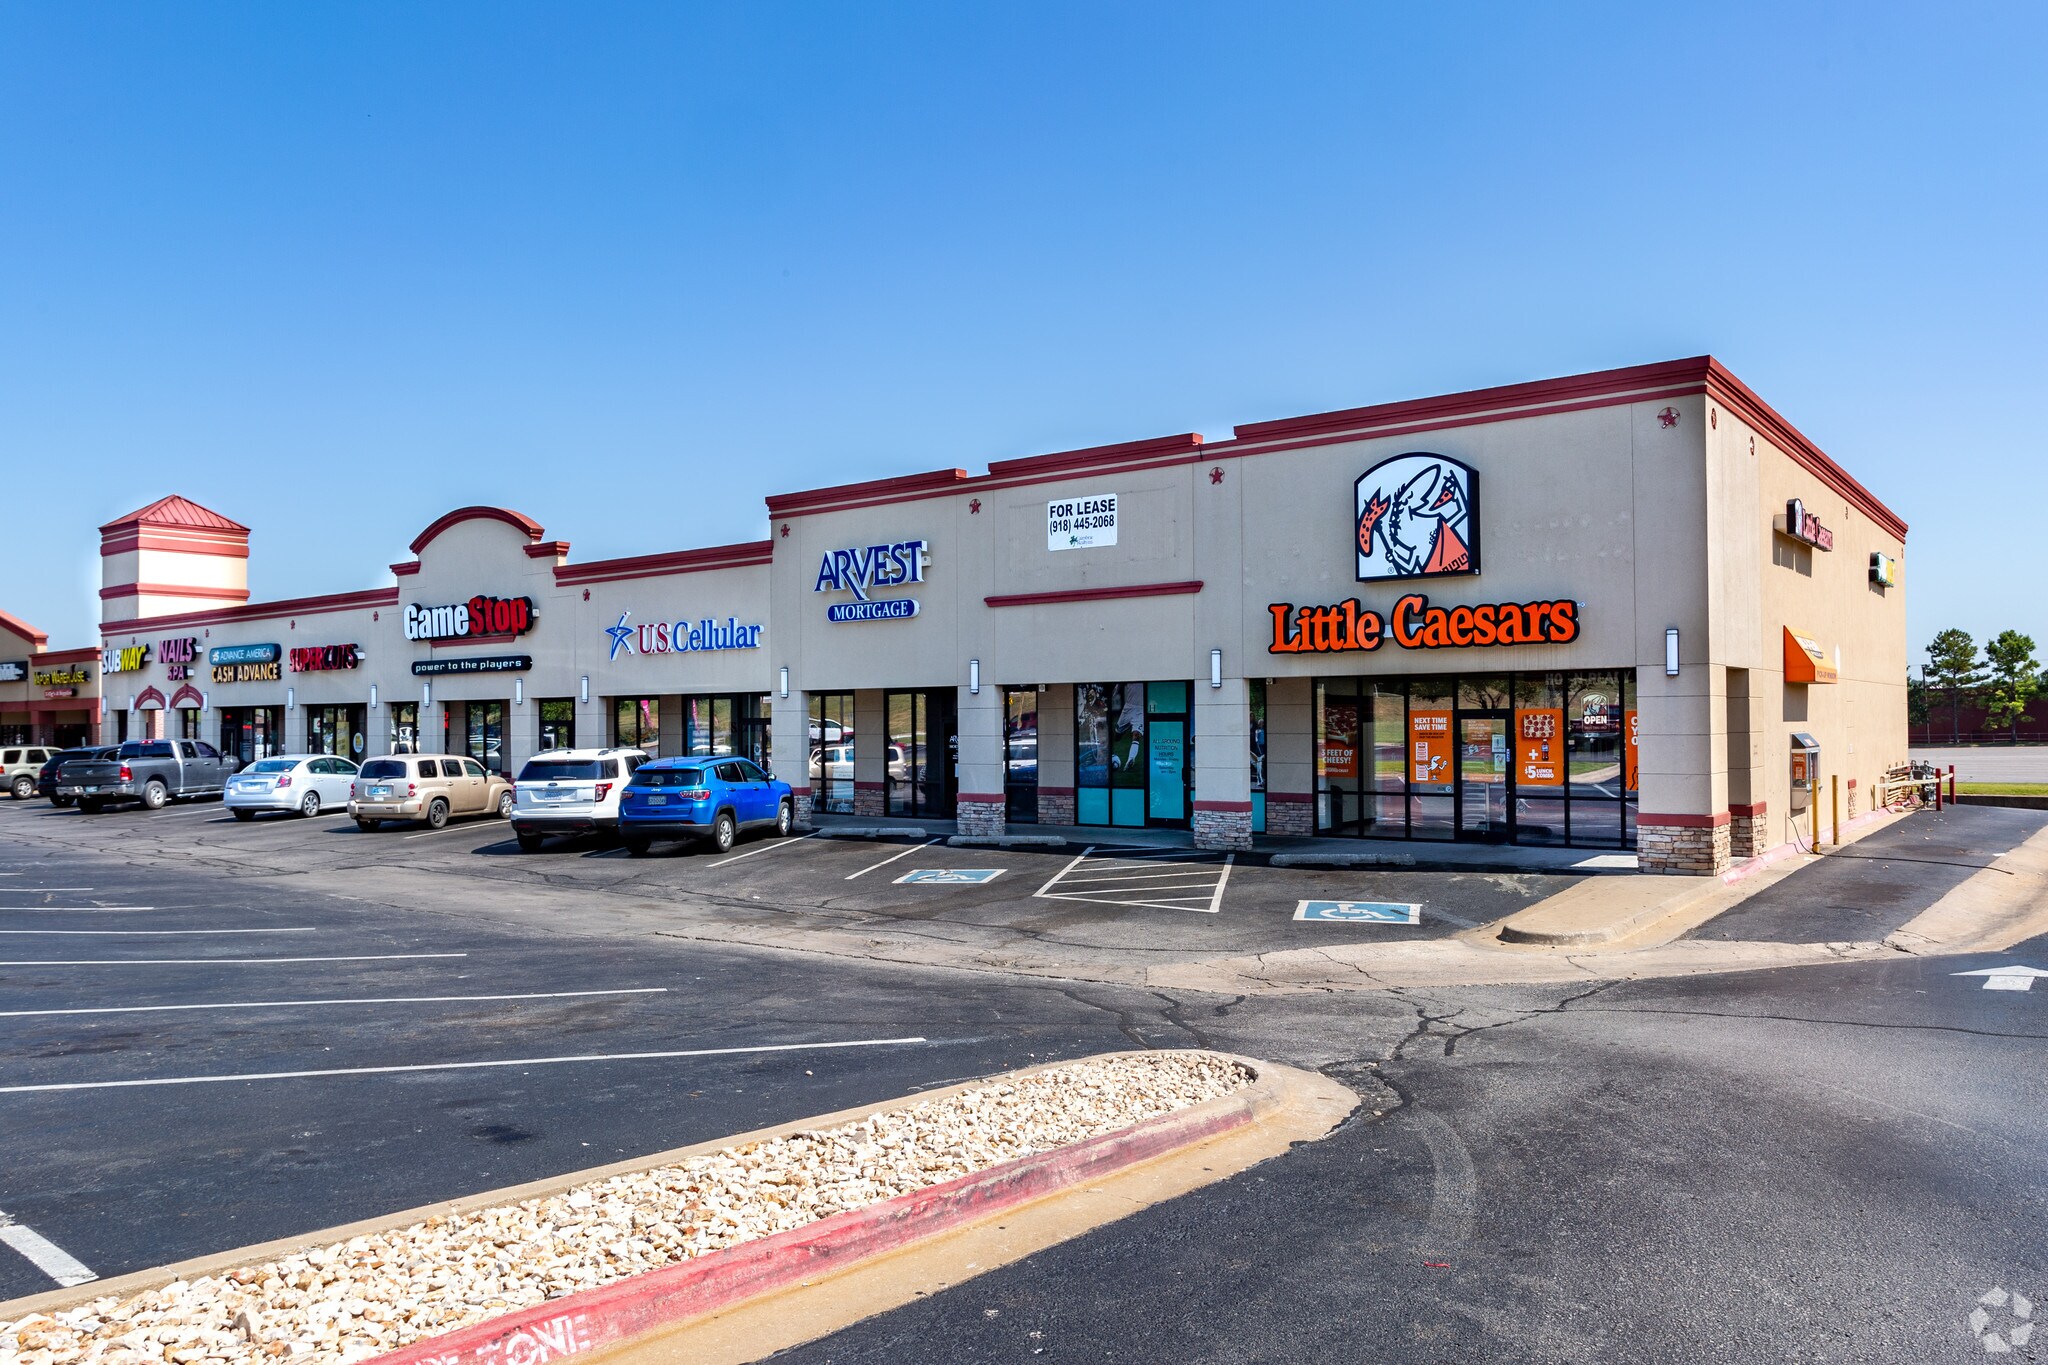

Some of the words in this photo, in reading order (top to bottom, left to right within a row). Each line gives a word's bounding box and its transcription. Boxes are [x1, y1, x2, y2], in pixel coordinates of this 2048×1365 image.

[1050, 503, 1073, 518] FOR
[1077, 499, 1115, 515] LEASE
[1050, 518, 1071, 536] (918)
[1074, 514, 1115, 530] 445-2068
[814, 540, 924, 601] ARVEST
[403, 596, 528, 640] GameStop
[834, 601, 909, 621] MORTGAGE
[1269, 597, 1383, 653] Little
[1393, 595, 1577, 648] Caesars
[102, 643, 147, 674] SUBWAY
[158, 637, 194, 664] NAILS
[220, 650, 245, 660] ADVANCE
[246, 648, 271, 659] AMERICA
[289, 643, 357, 673] SUPERCUTS
[168, 665, 185, 681] SPA
[211, 665, 234, 683] CASH
[237, 663, 278, 682] ADVANCE
[415, 664, 445, 673] power
[448, 662, 458, 670] to
[460, 660, 477, 669] the
[480, 659, 522, 671] players
[1583, 715, 1608, 725] OPEN
[1322, 756, 1351, 764] CHEESY!
[1327, 749, 1343, 757] FEET
[1344, 749, 1354, 757] OF
[1525, 765, 1537, 779] $5
